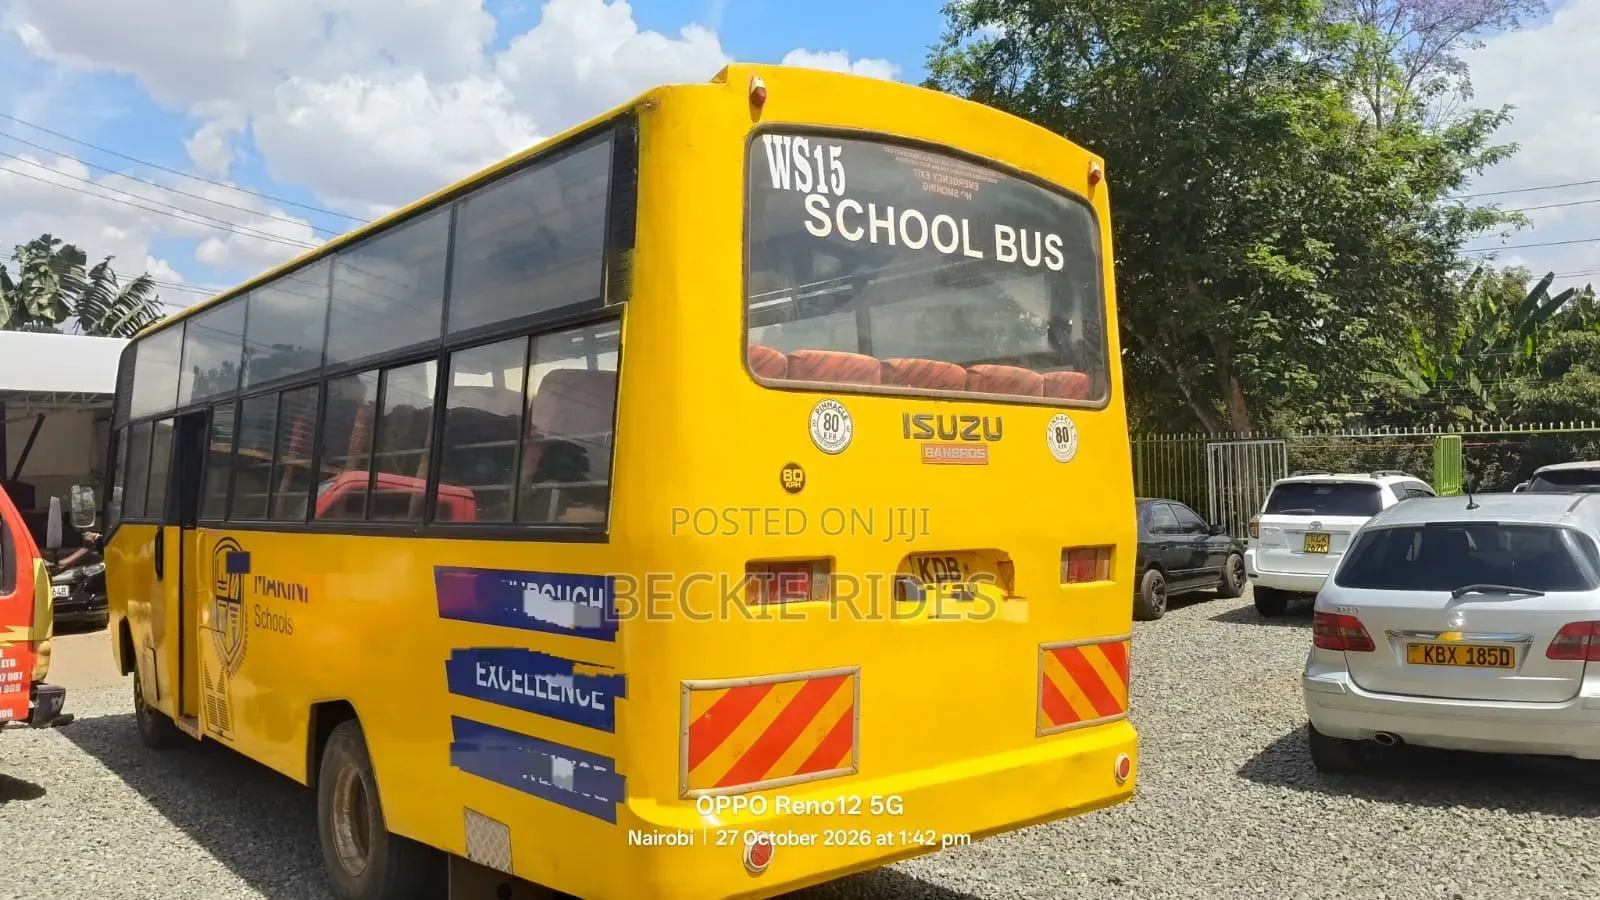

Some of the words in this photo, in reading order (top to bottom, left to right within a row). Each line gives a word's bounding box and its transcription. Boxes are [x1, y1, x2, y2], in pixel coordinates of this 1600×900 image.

[763, 134, 846, 196] WS15
[804, 193, 983, 259] SCHOOL
[995, 224, 1064, 271] BUS
[815, 401, 848, 420] PINNACLE
[823, 412, 839, 433] 80
[903, 412, 1003, 441] ISUZU
[1055, 426, 1069, 444] 80
[783, 468, 803, 482] 80
[785, 481, 801, 489] KPH
[917, 556, 962, 584] KDB
[255, 603, 293, 636] Schools
[1424, 645, 1457, 665] KBX
[1465, 647, 1510, 666] 185D
